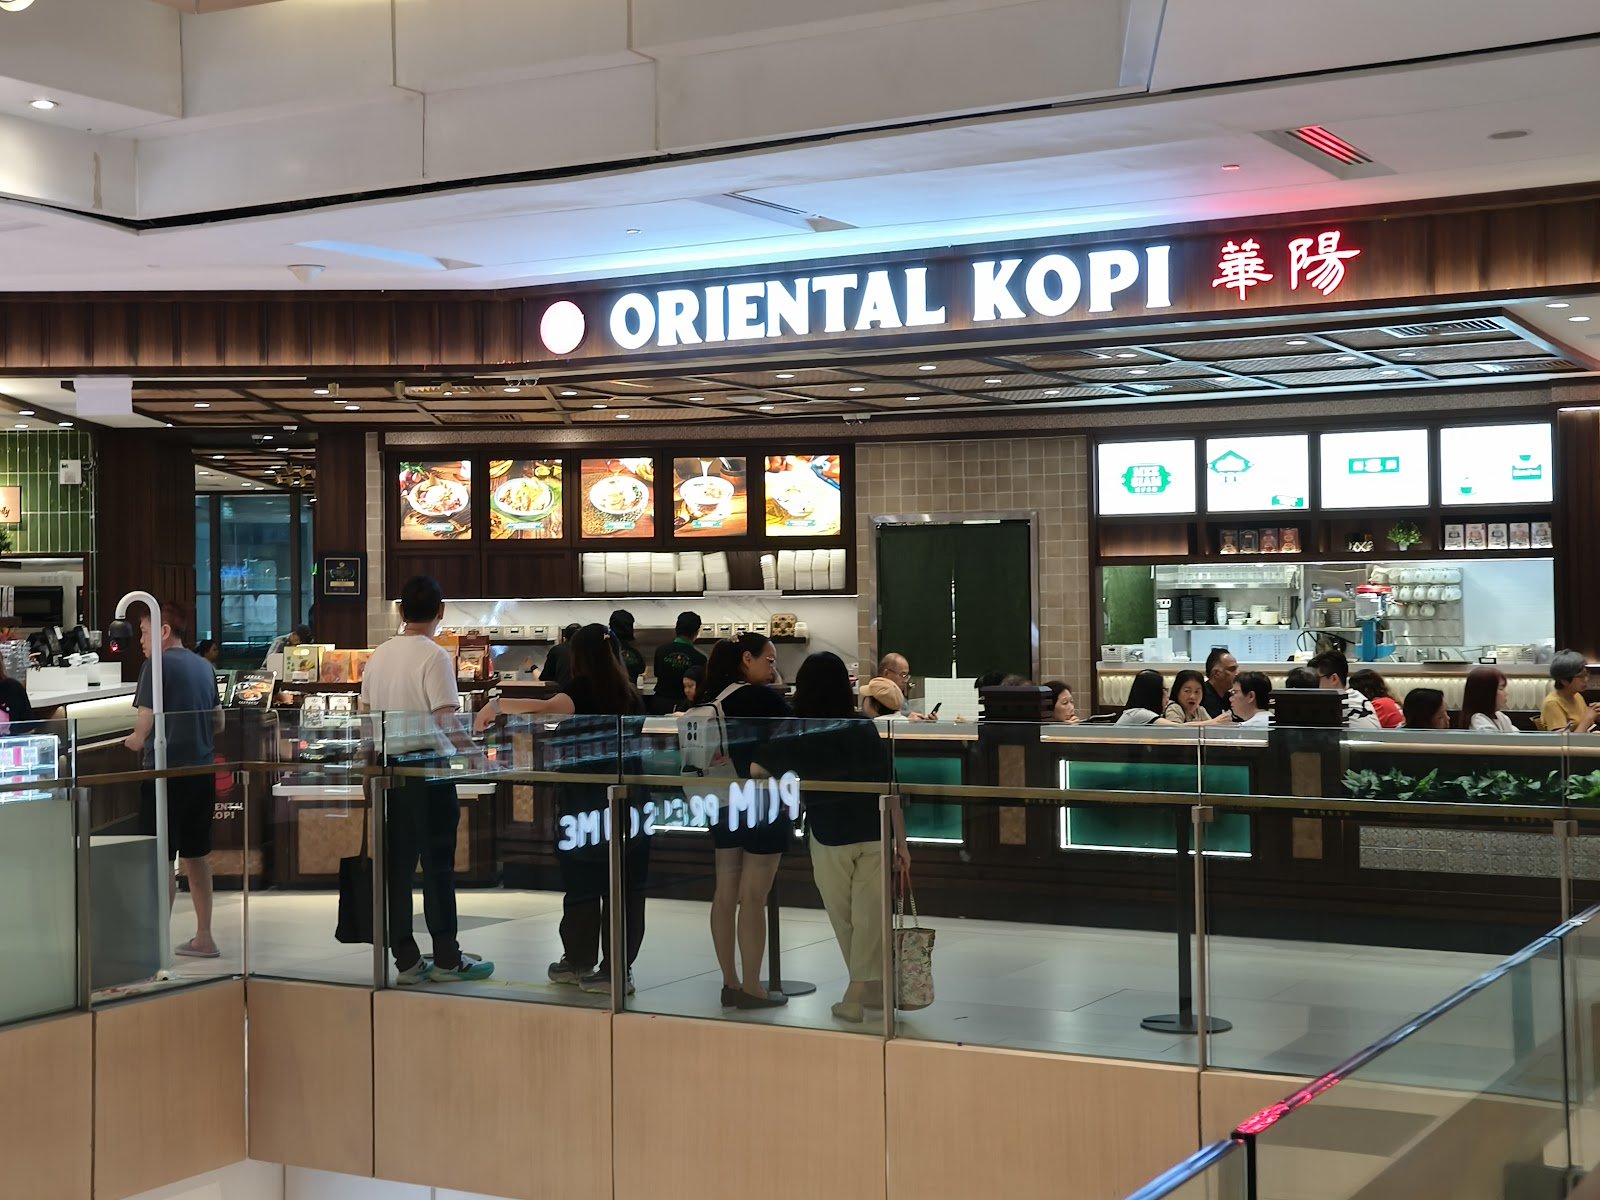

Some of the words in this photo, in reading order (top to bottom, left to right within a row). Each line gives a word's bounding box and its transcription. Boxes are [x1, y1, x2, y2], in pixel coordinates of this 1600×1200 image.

[608, 267, 946, 351] ORIENTAL
[972, 245, 1172, 323] KOPI
[1211, 230, 1361, 301] 華陽
[212, 811, 235, 820] OPI
